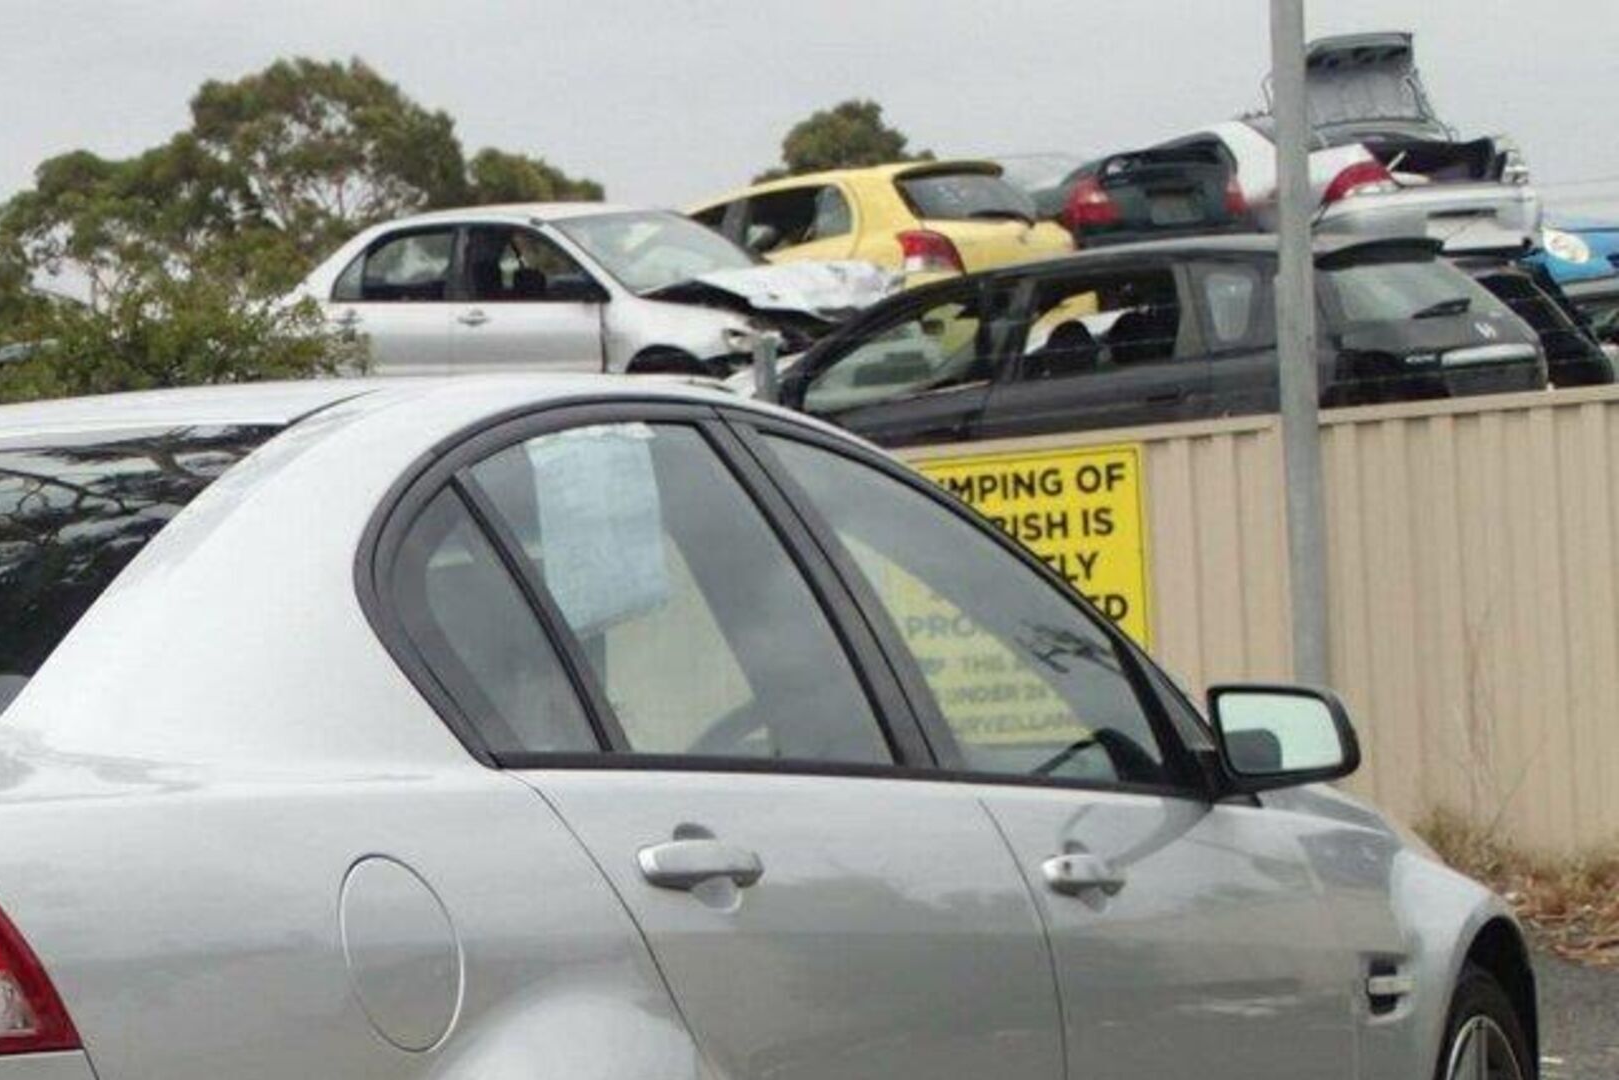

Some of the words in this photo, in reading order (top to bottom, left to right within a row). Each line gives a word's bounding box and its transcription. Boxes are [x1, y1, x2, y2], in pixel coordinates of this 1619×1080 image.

[939, 468, 1063, 502] MPING
[1076, 462, 1125, 494] OF
[1082, 506, 1116, 538] IS
